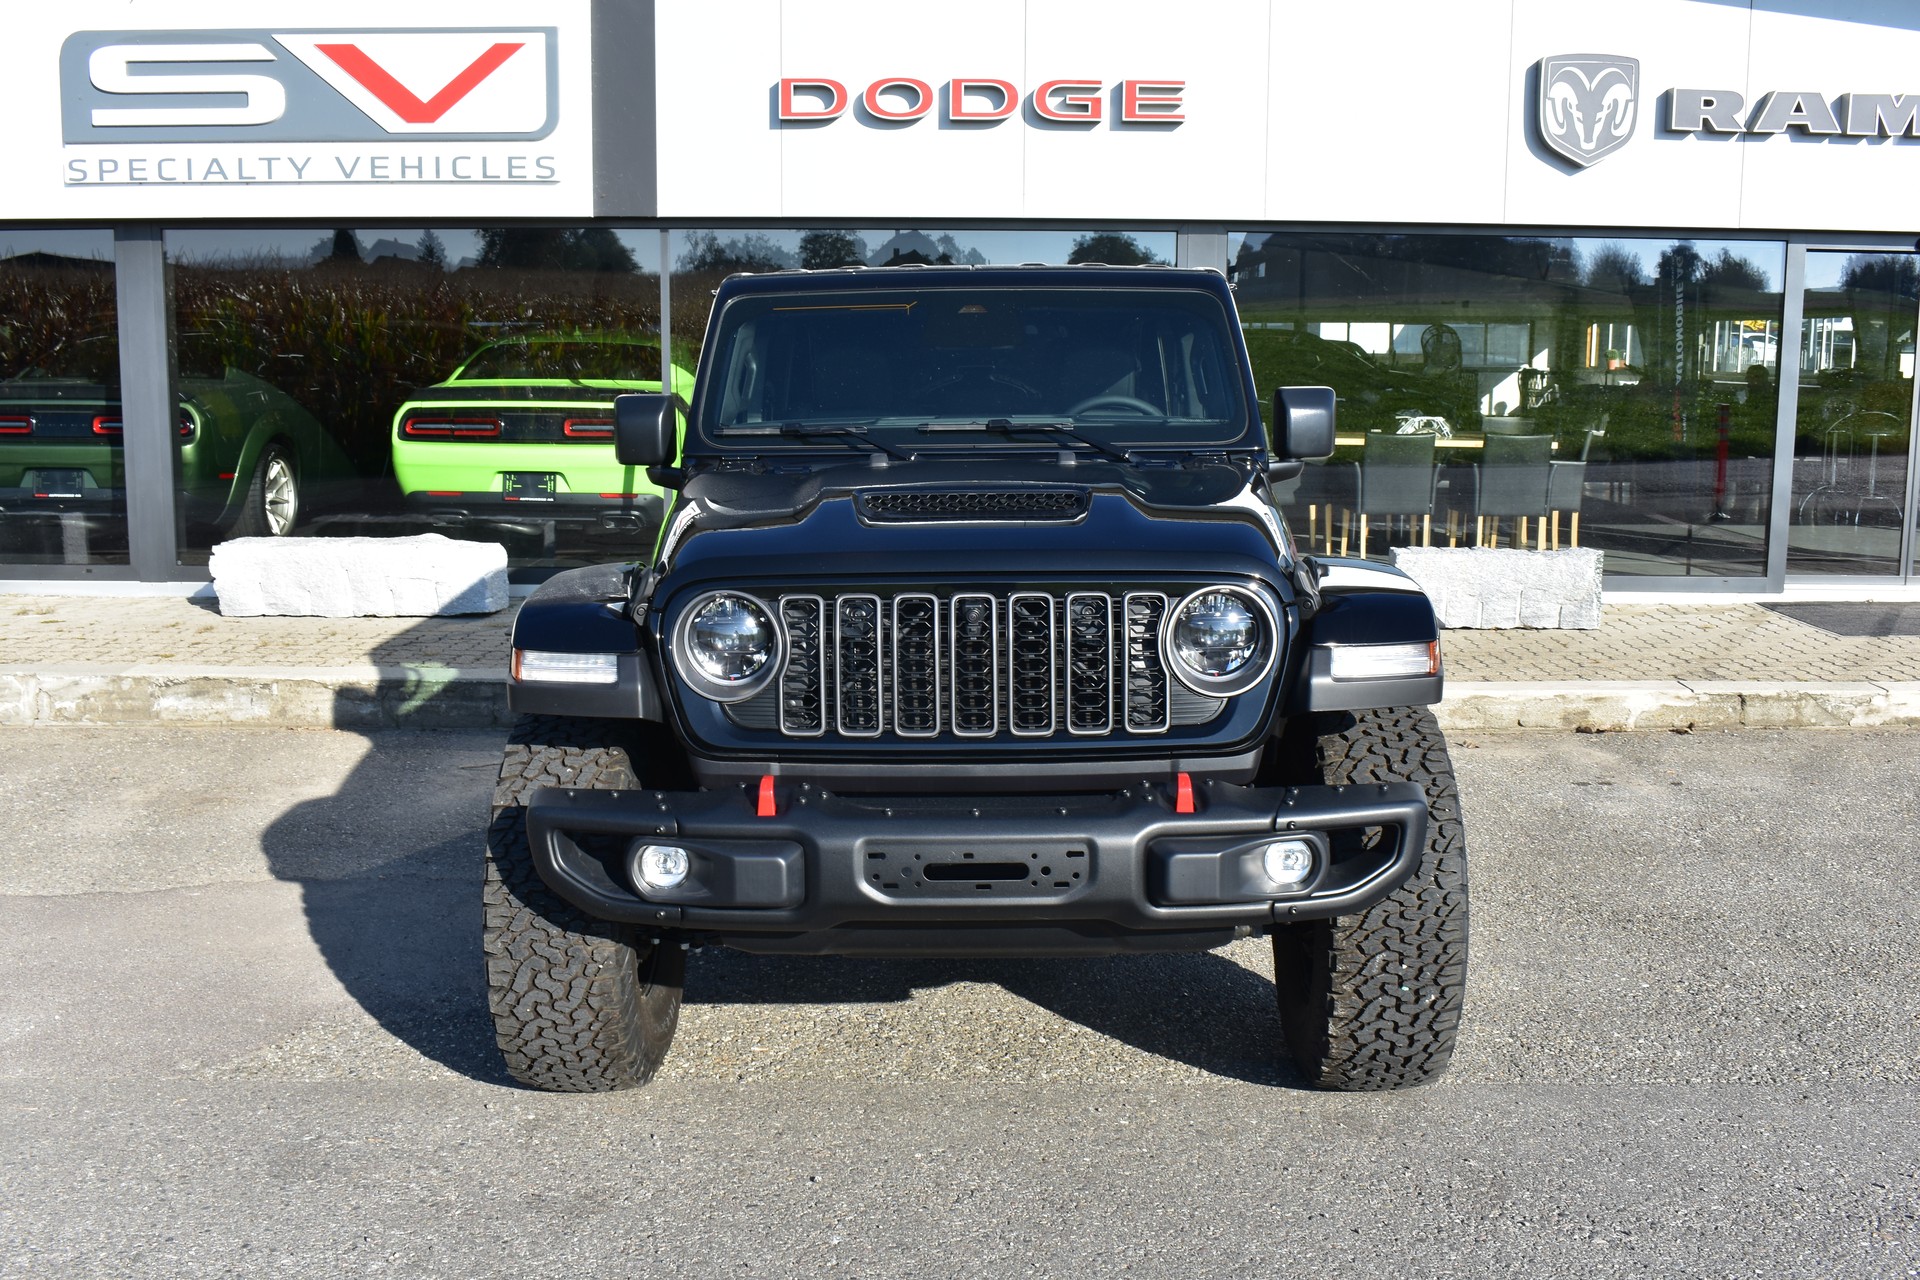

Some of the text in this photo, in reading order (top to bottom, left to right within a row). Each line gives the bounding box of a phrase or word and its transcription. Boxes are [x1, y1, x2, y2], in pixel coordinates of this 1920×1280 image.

[778, 77, 1186, 122] DODGE
[1672, 87, 1920, 136] RAM
[67, 156, 557, 182] SPECIALTY VEHICLES
